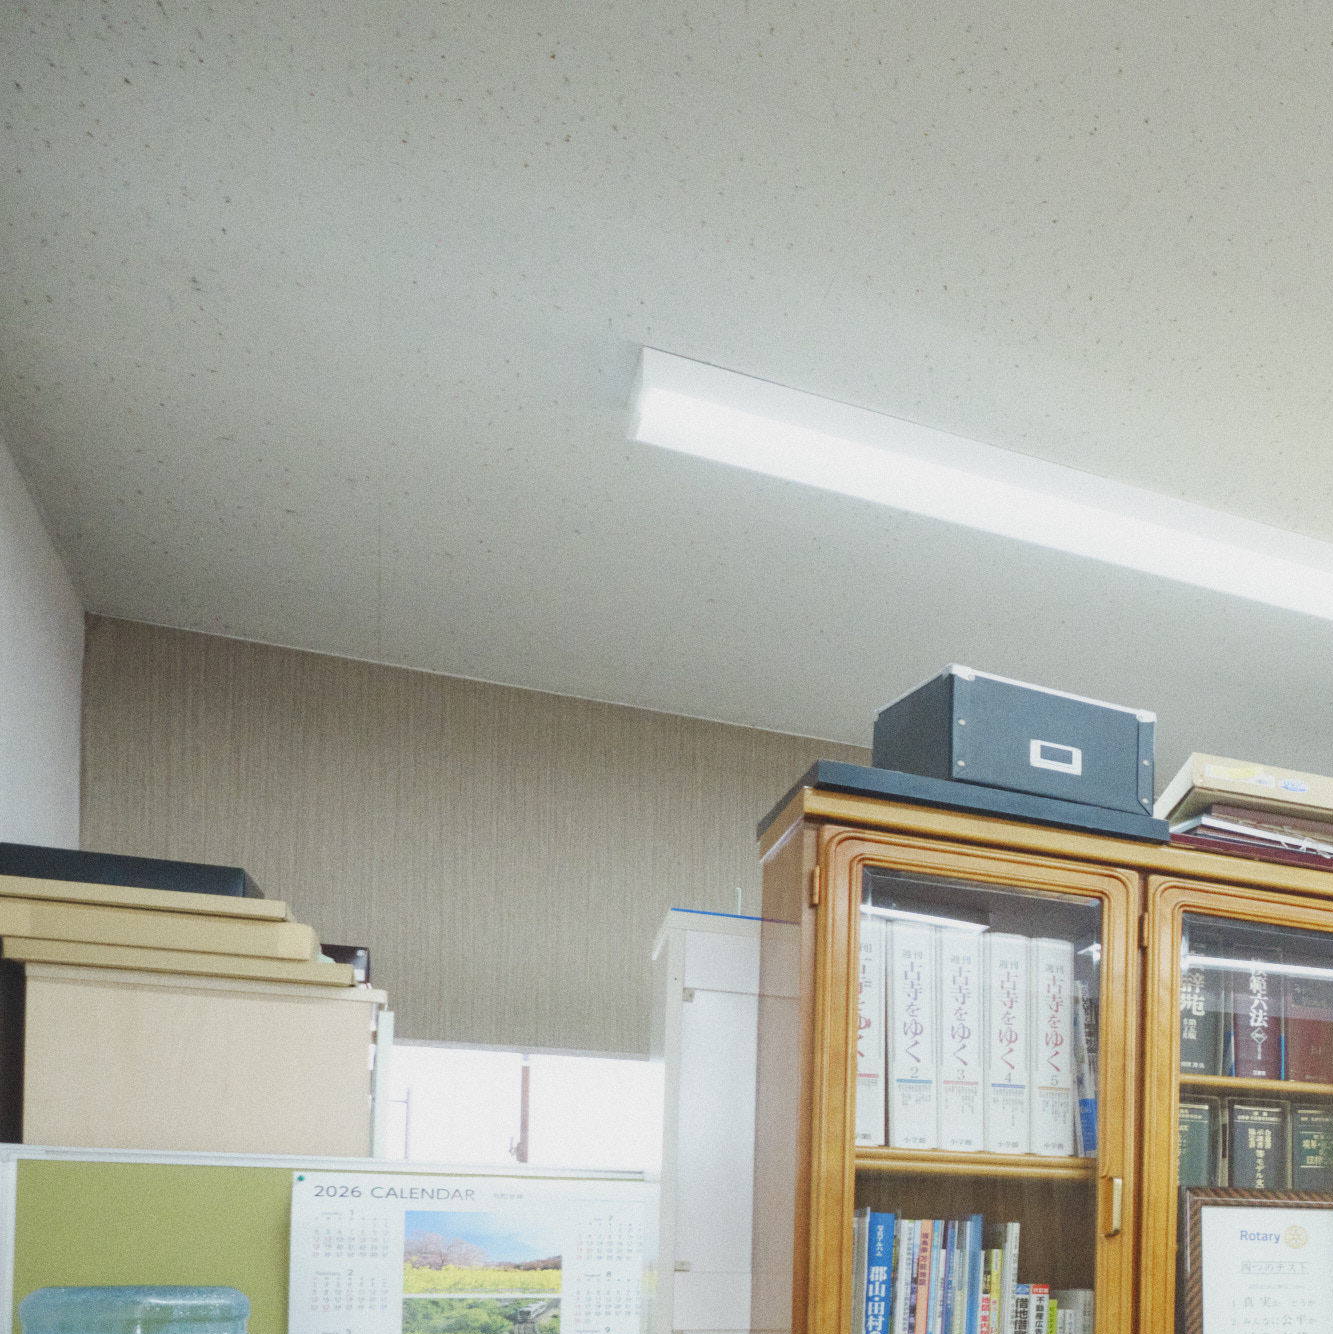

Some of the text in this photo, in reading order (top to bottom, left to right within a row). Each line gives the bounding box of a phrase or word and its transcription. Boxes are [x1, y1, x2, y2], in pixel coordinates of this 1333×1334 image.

[903, 961, 923, 1064] 古寺をゆく
[950, 967, 971, 1067] 古寺をゆく
[998, 971, 1019, 1070] 古寺をゆく
[1045, 975, 1064, 1072] 古寺をゆく
[910, 1067, 918, 1078] 2
[957, 1069, 965, 1081] 3
[1004, 1072, 1012, 1083] 4
[1050, 1075, 1058, 1086] 5
[314, 1185, 362, 1198] 2026
[370, 1186, 475, 1200] CALENDAR
[1240, 1230, 1281, 1243] Rotary
